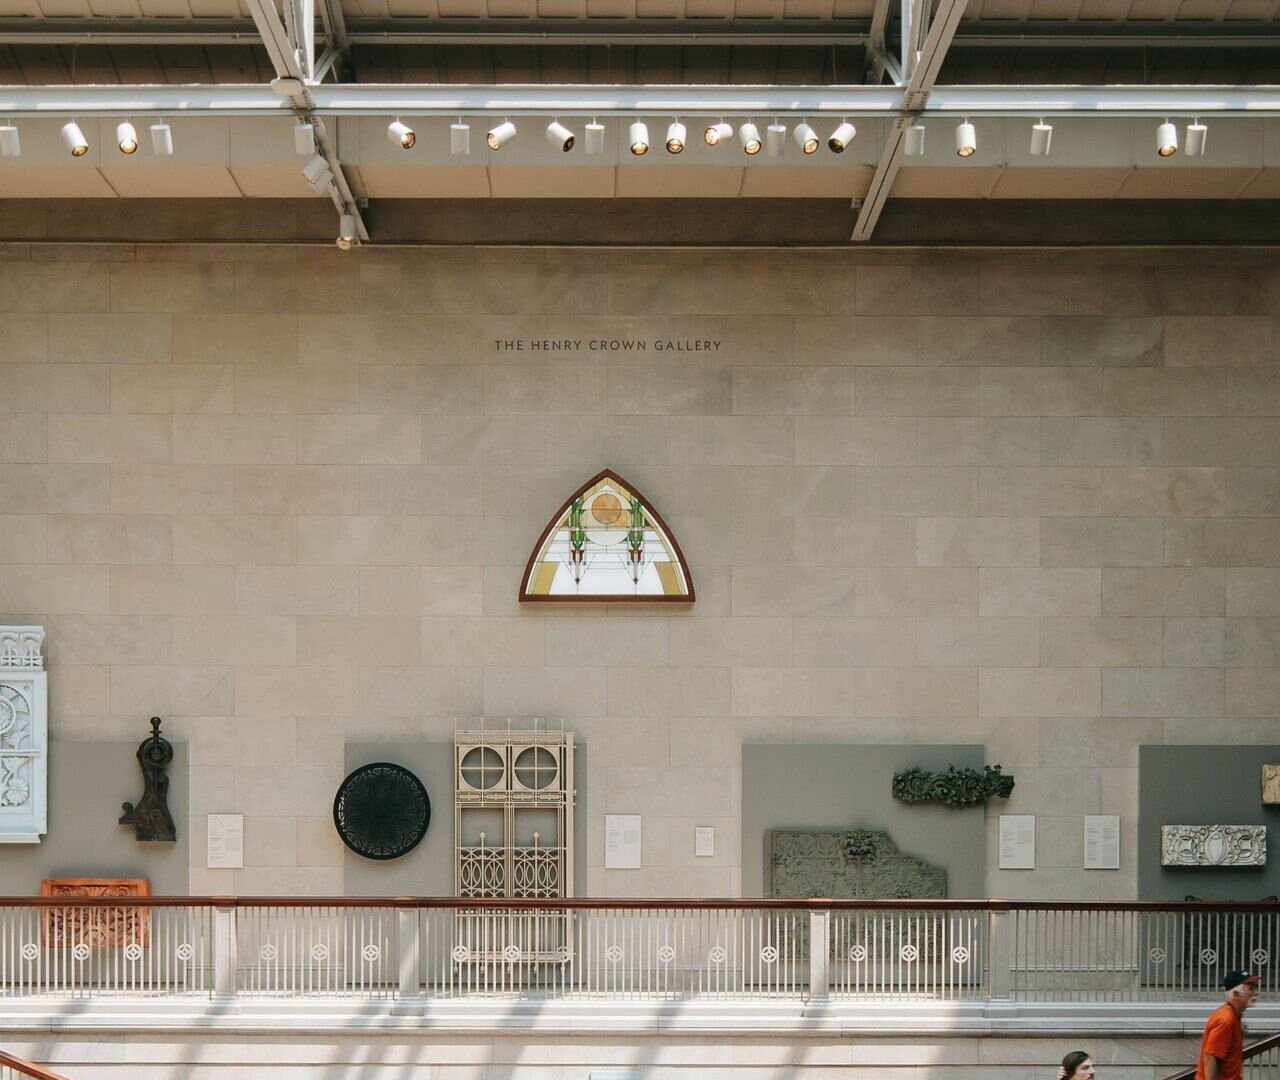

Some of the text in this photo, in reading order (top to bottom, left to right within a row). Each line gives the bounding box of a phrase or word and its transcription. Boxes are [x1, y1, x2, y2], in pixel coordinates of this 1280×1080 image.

[494, 340, 722, 351] THE HENRY CROWN GALLERY
